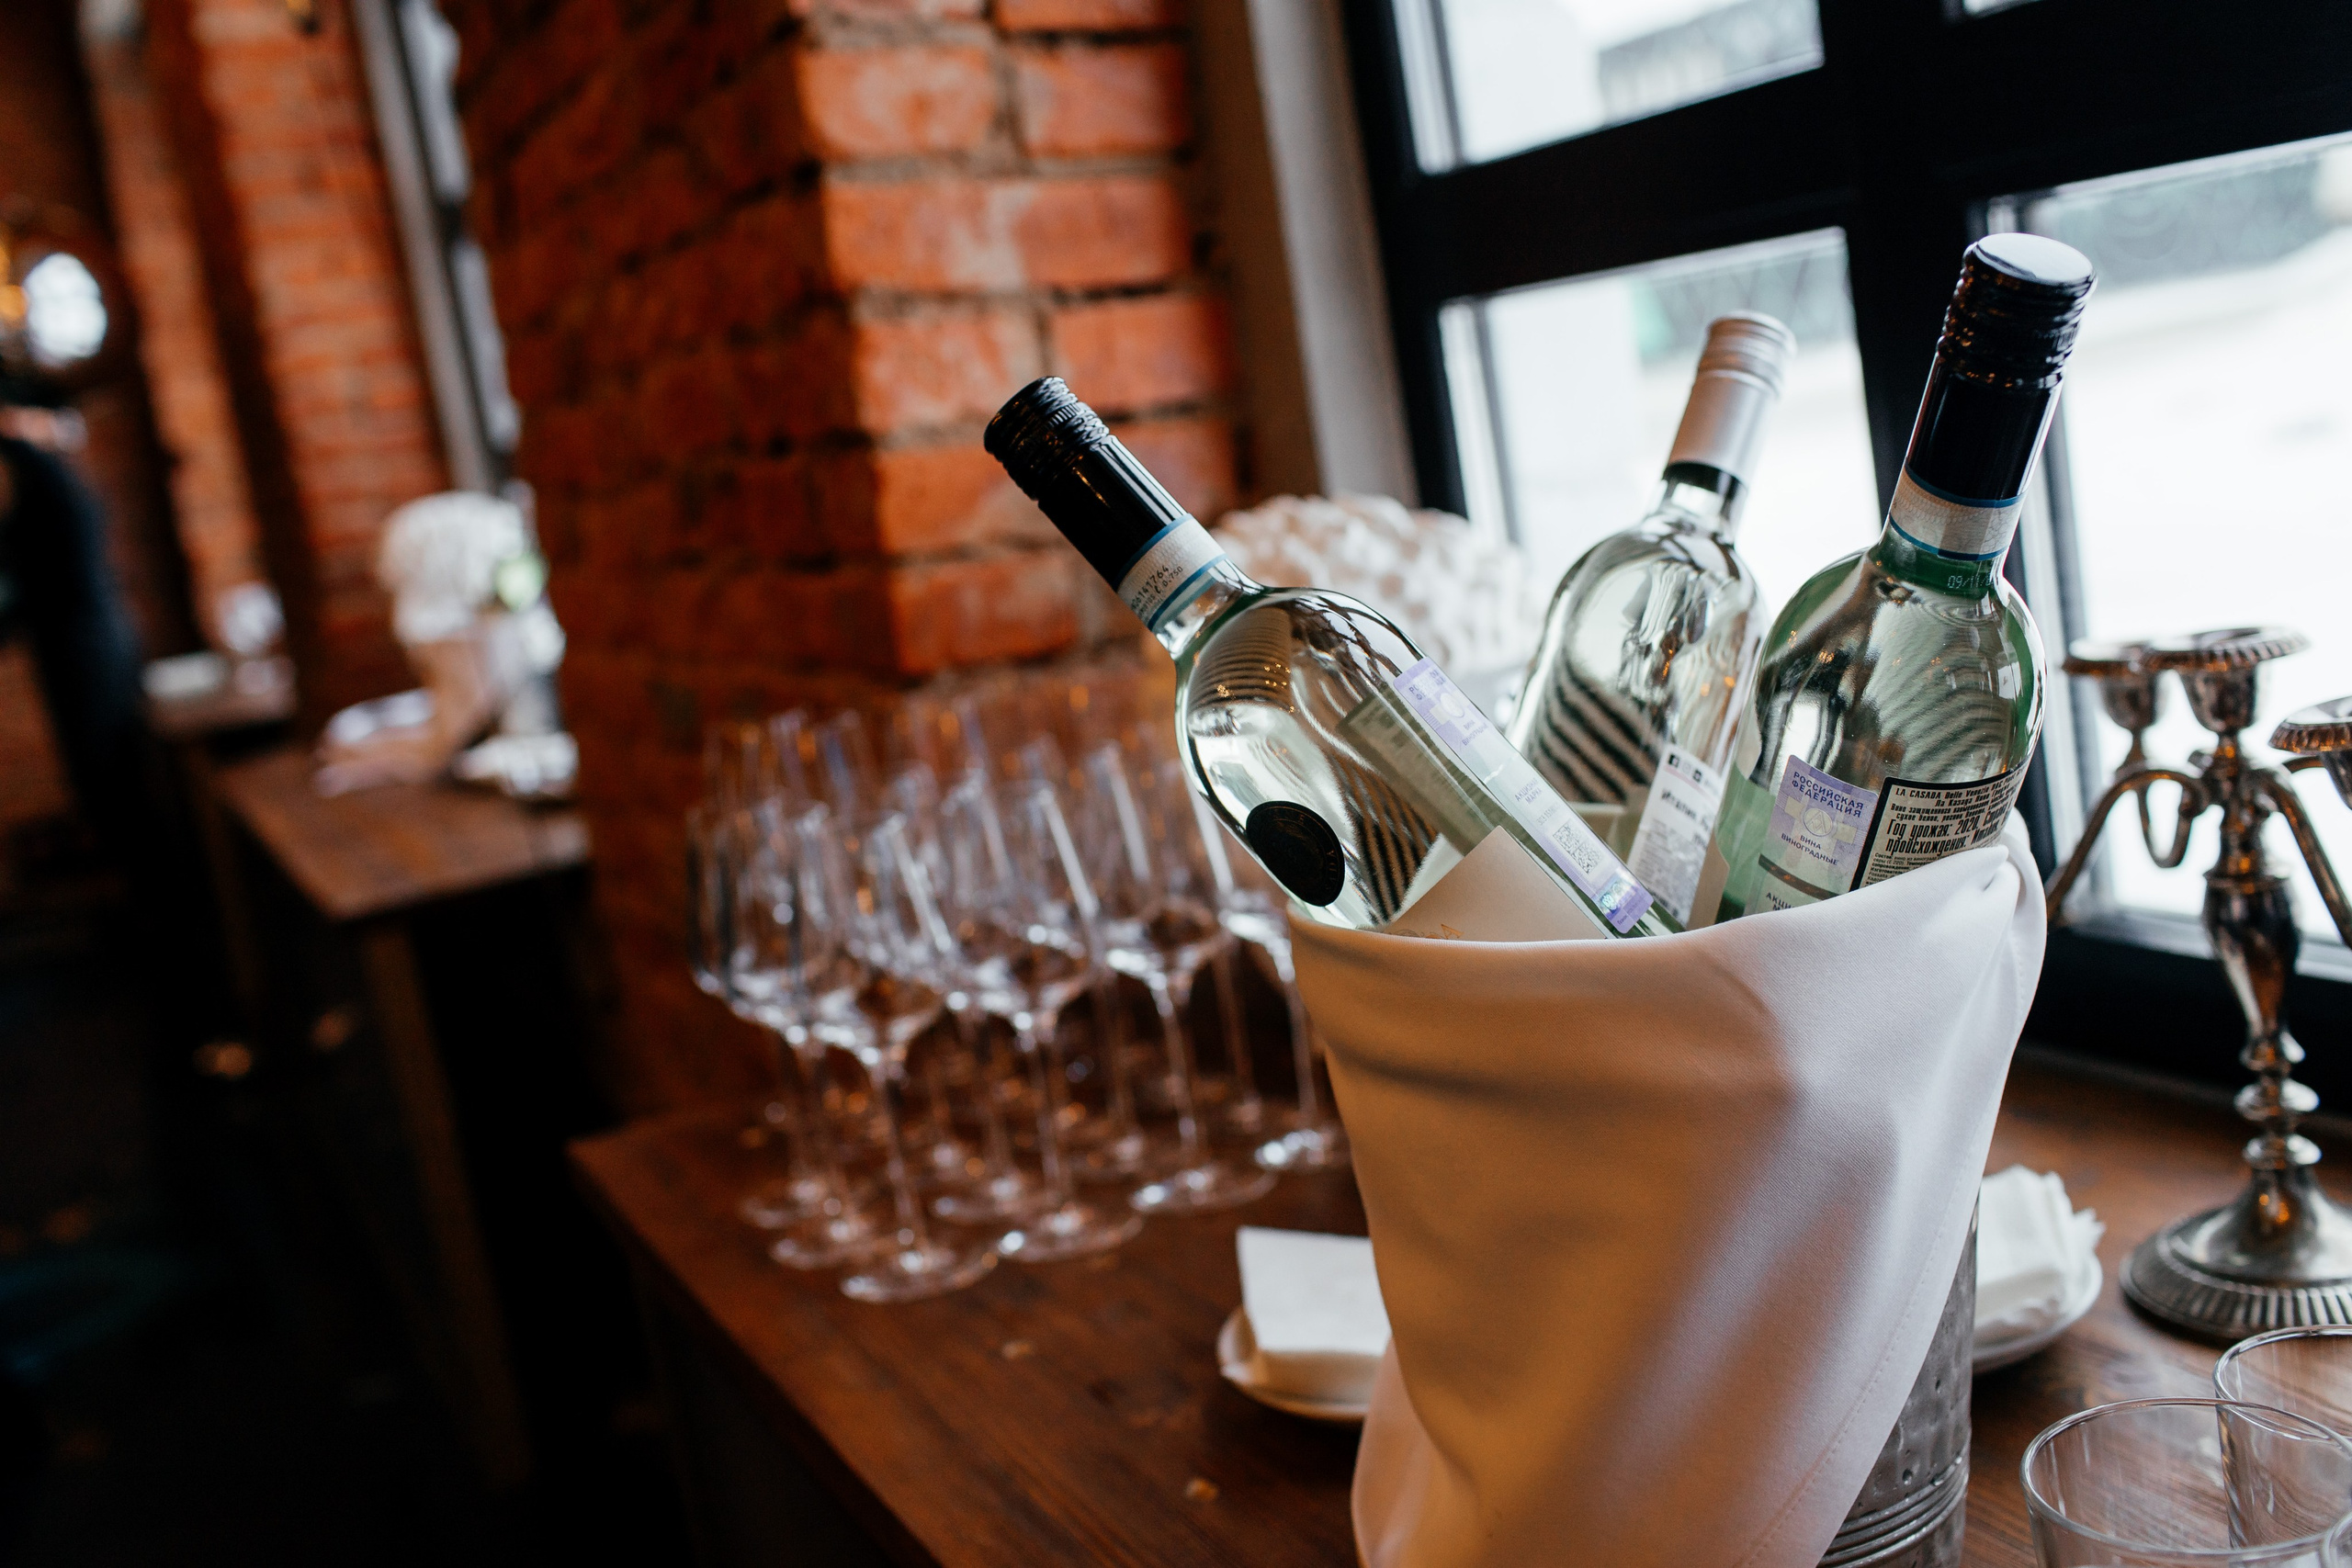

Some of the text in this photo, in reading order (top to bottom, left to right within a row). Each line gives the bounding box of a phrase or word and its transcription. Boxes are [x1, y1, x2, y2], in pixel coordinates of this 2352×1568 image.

[1792, 779, 1862, 818] ФЕДЕРАЦИЯ
[1793, 772, 1864, 810] РОССИЙСКАЯ
[1895, 787, 1905, 796] LA
[1909, 790, 1941, 799] CASADA
[1944, 791, 1963, 799] Delle
[1965, 786, 1989, 797] Venezie
[1890, 803, 1907, 812] Вино
[1895, 813, 1916, 821] сухое
[1886, 819, 1907, 840] Год
[1908, 824, 1953, 841] урожая:
[1954, 815, 1980, 836] 2020.
[1781, 833, 1839, 866] ВИНОГРАДНЫЕ
[1800, 834, 1822, 850] ВИНА
[1885, 835, 1970, 856] происхождения:
